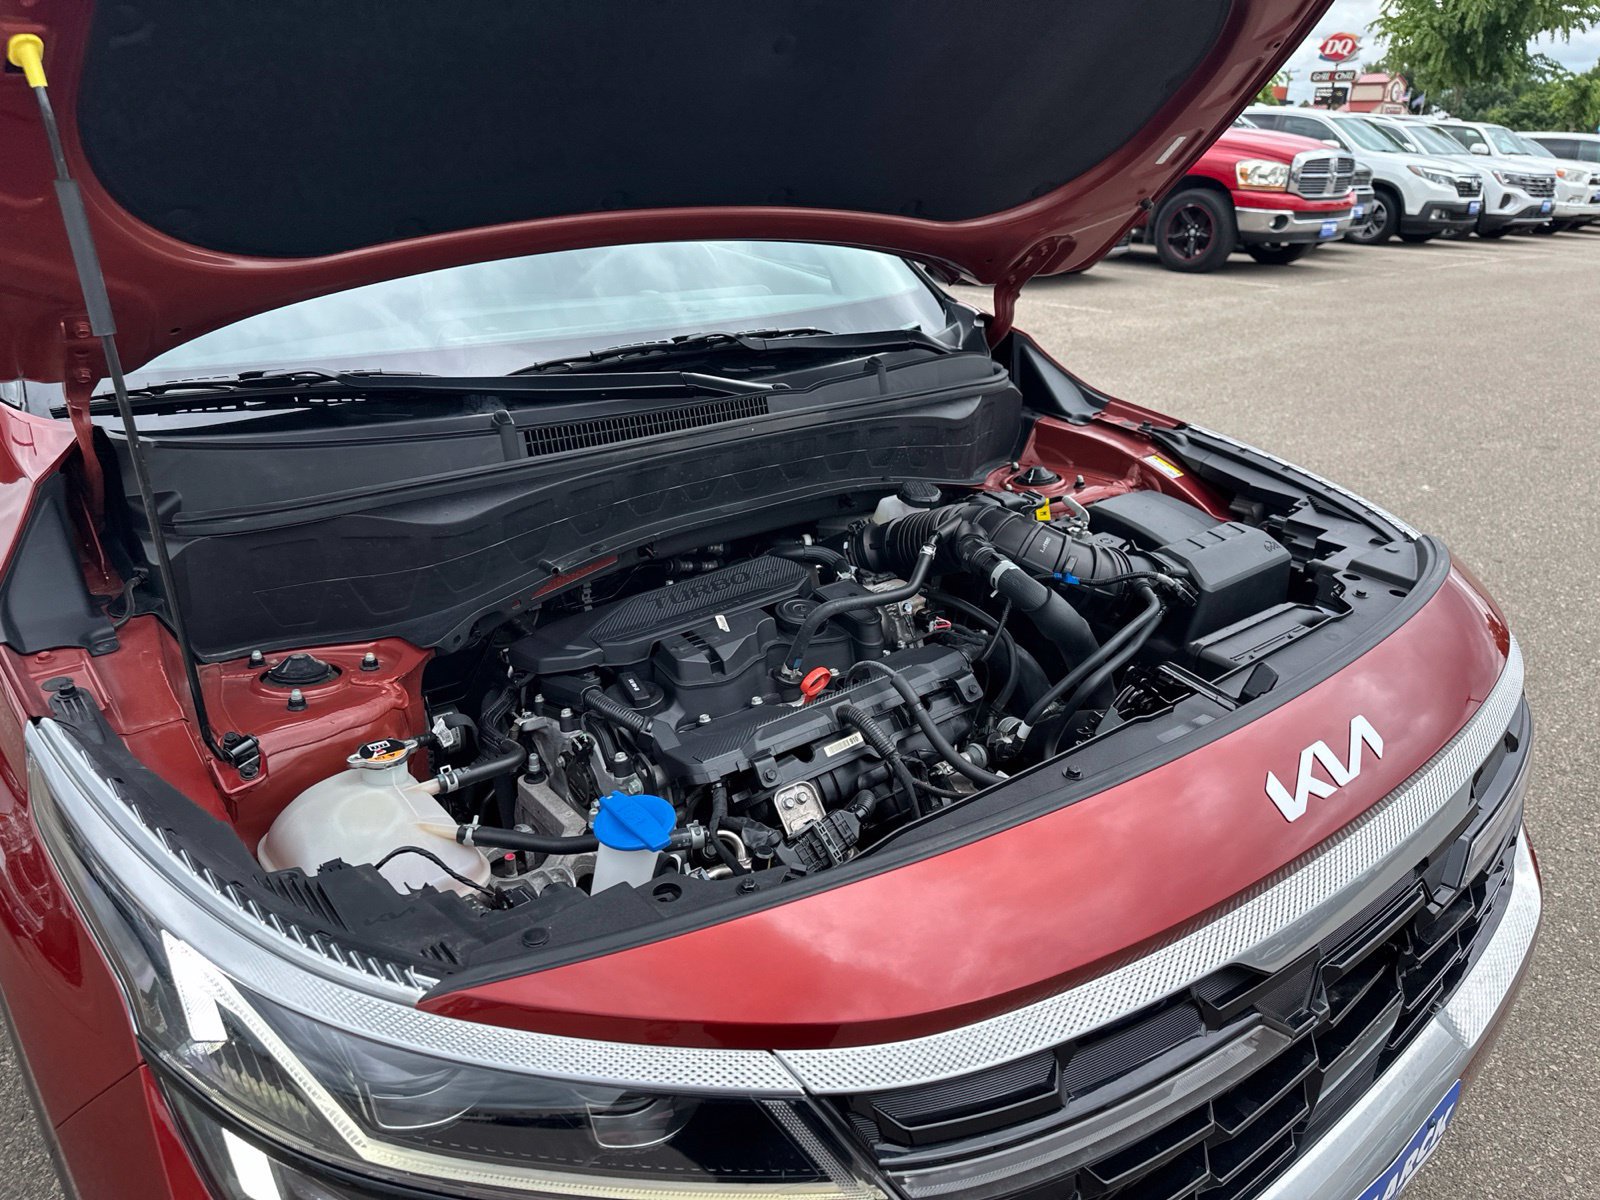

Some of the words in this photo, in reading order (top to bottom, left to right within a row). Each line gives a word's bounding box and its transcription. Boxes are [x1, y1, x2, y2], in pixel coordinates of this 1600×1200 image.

[1324, 38, 1353, 56] DQ
[647, 571, 751, 609] TURBO
[1372, 1101, 1456, 1200] ARCK
